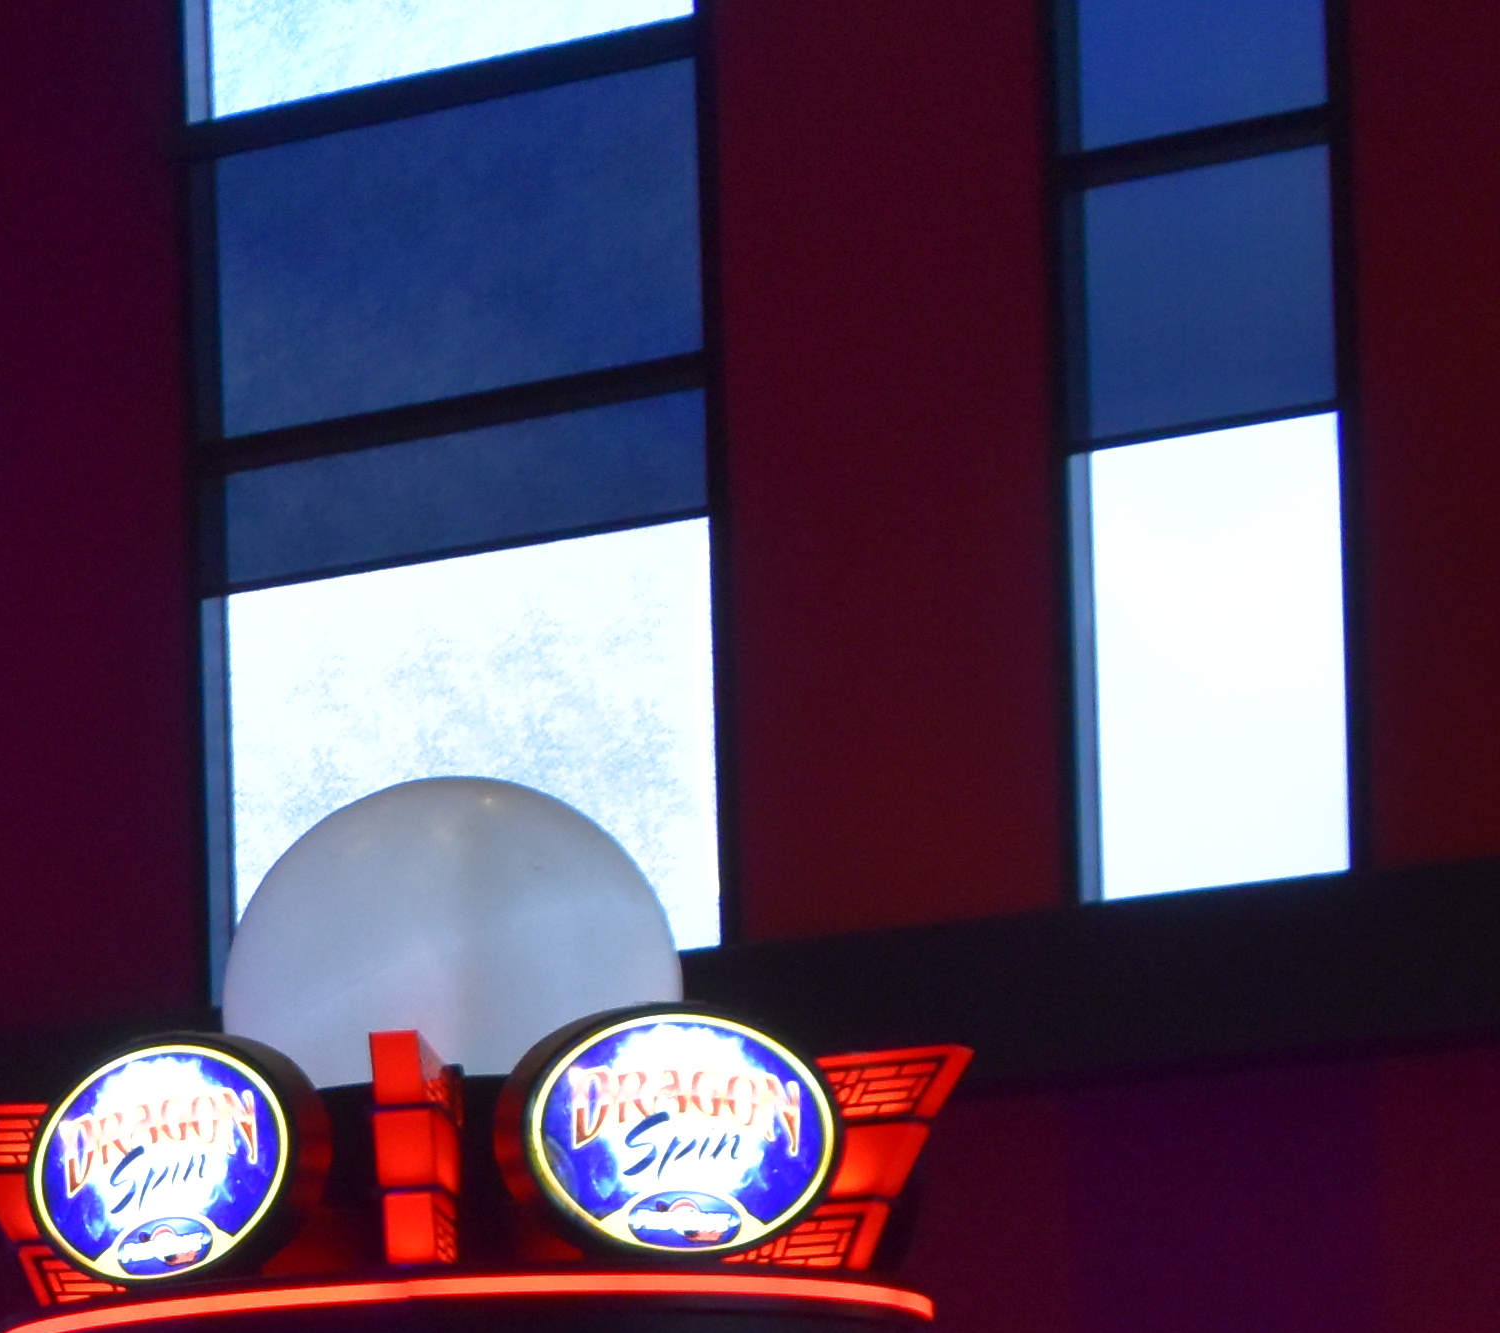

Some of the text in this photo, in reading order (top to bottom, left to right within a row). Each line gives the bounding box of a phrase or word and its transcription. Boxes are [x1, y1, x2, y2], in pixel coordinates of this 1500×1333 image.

[59, 1088, 257, 1198] DRAGON
[569, 1065, 800, 1156] DRAGON
[622, 1111, 741, 1180] Spin
[110, 1146, 206, 1214] Spin
